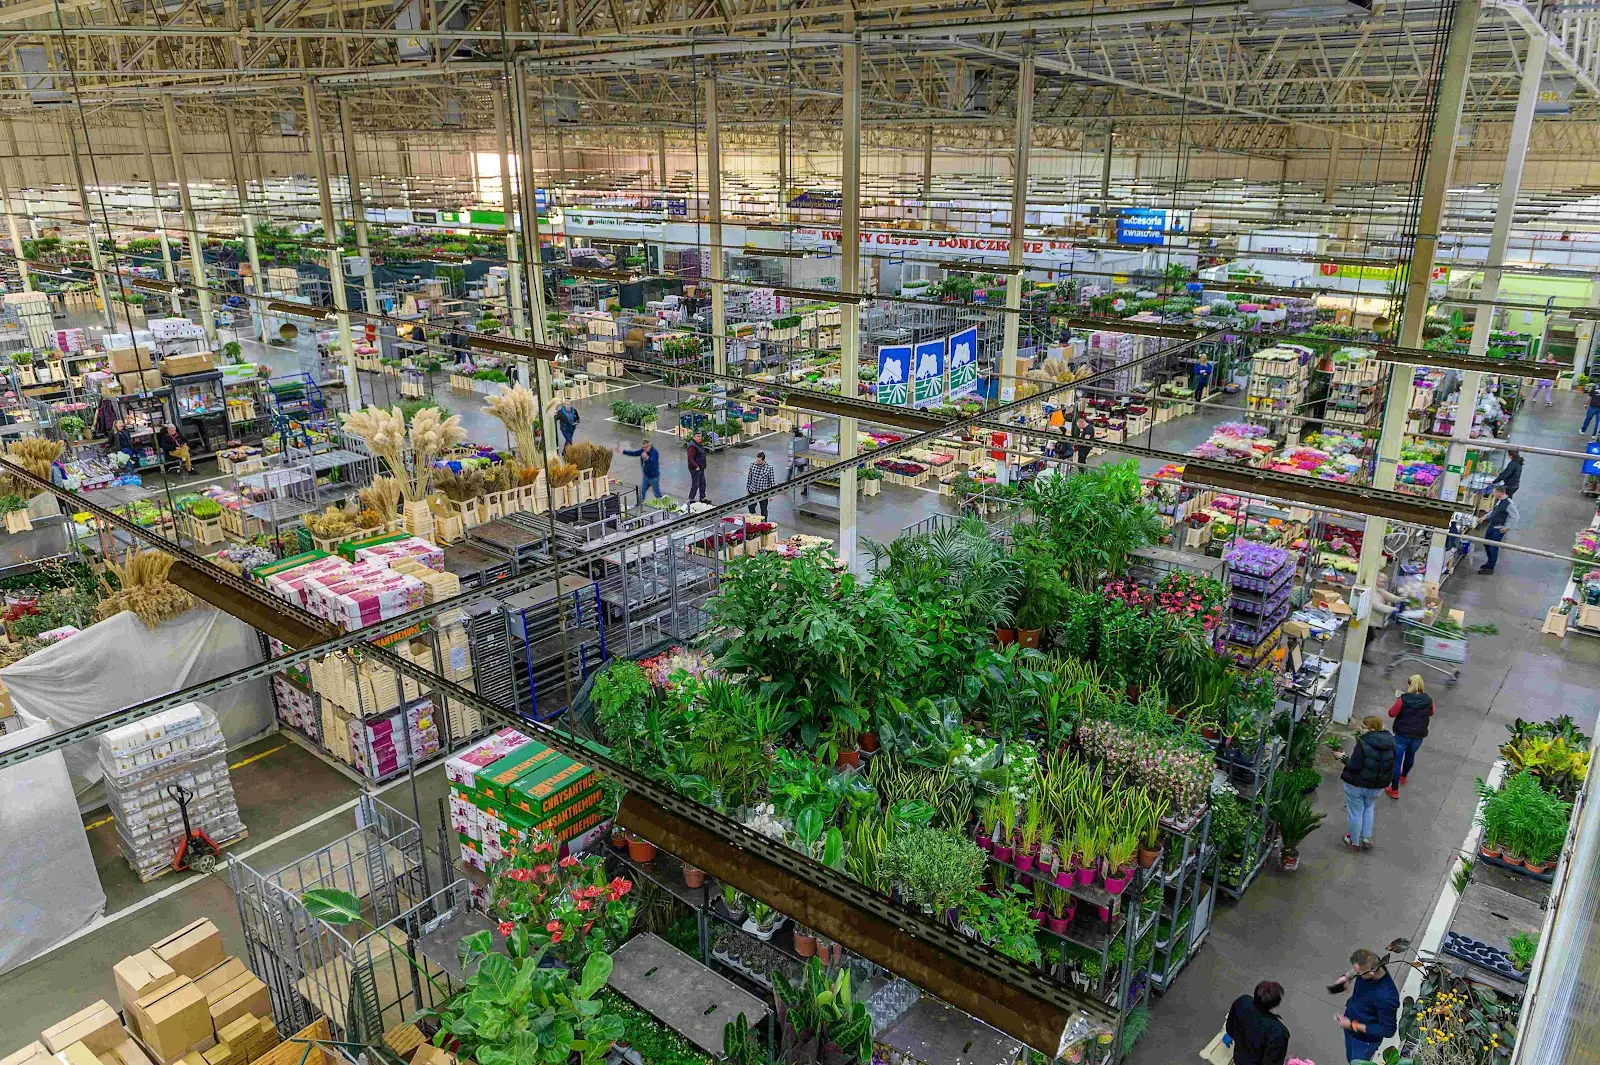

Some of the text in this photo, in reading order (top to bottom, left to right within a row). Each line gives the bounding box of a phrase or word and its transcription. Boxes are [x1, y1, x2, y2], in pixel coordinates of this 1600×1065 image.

[821, 230, 873, 243] KWTY
[938, 237, 1043, 253] DONICZKWE
[542, 773, 597, 813] CHRYSANTHE
